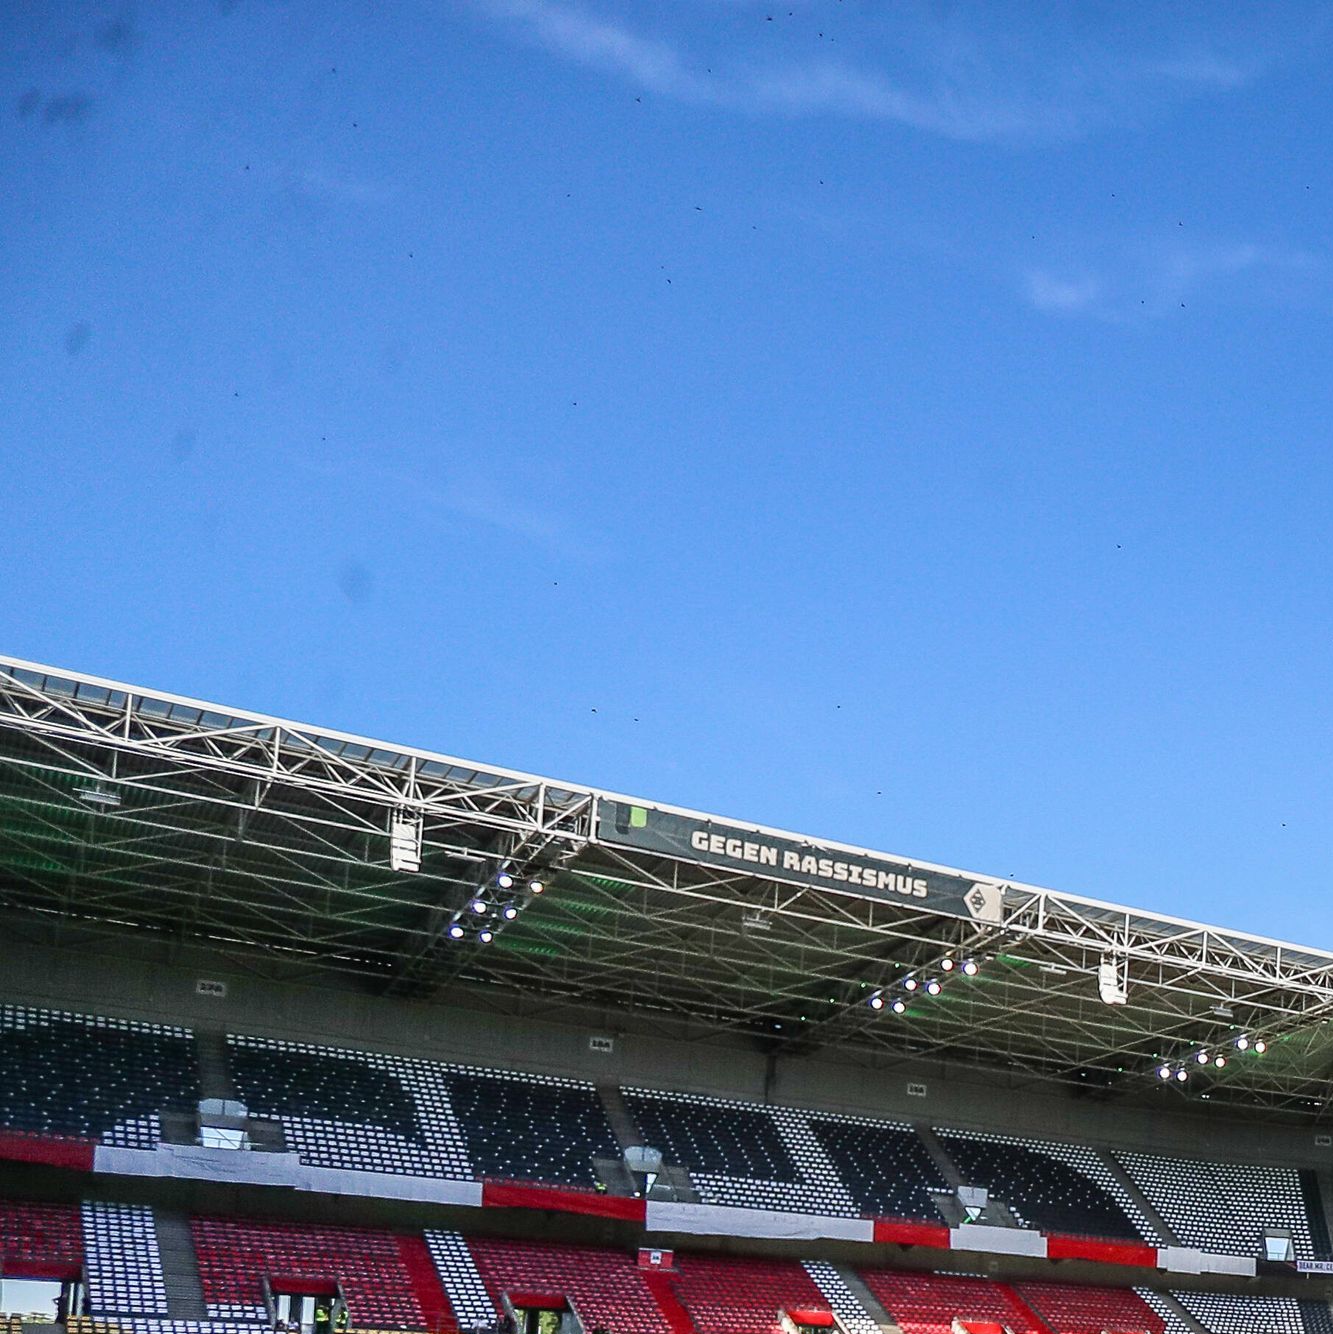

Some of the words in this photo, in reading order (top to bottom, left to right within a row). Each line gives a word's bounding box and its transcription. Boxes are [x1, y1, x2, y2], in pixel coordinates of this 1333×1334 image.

[690, 830, 778, 867] GEGEN
[782, 850, 929, 899] RASSISMUS
[1298, 1261, 1313, 1270] DEAR
